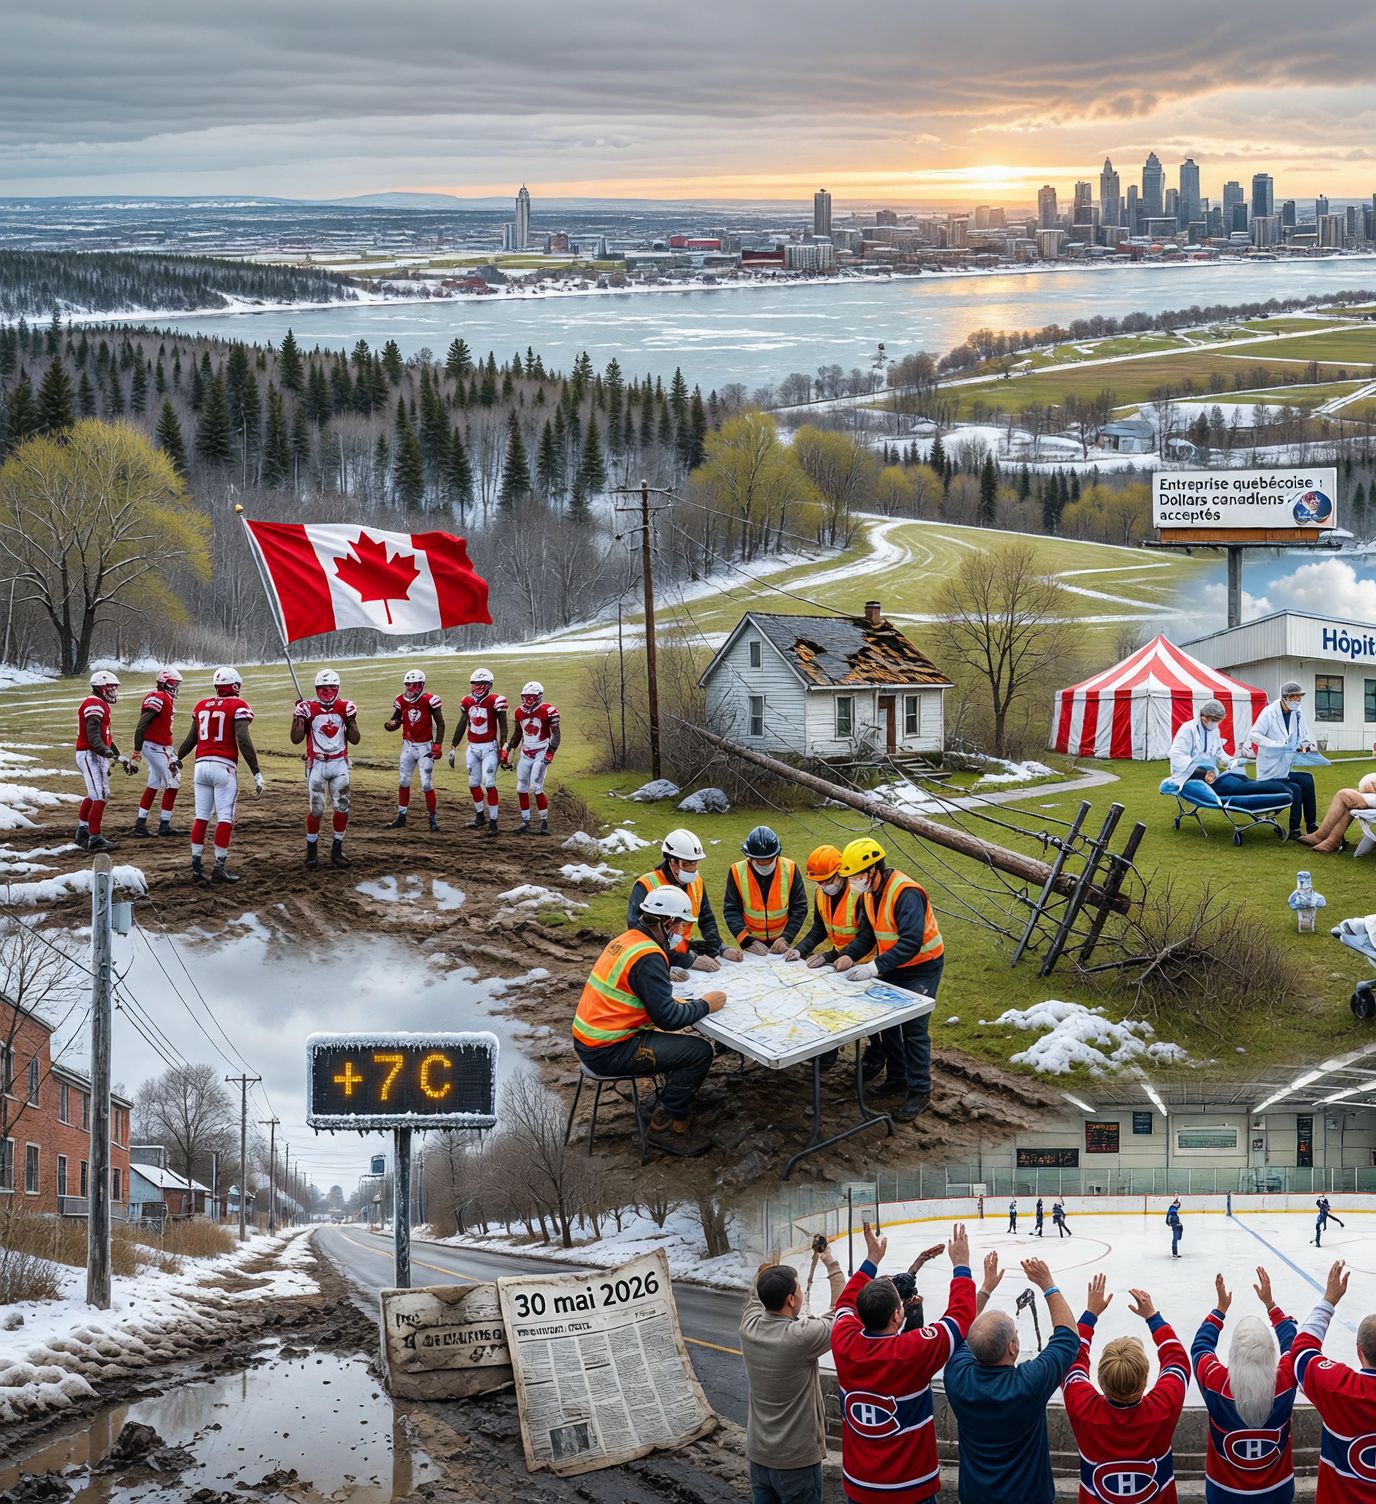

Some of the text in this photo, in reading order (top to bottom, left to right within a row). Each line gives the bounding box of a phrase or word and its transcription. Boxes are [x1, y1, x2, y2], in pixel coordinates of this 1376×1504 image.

[1159, 477, 1229, 493] Entreprise
[1159, 493, 1208, 506] Dollars
[514, 1292, 546, 1318] 30
[553, 1286, 596, 1314] mai
[599, 1271, 660, 1307] 2026
